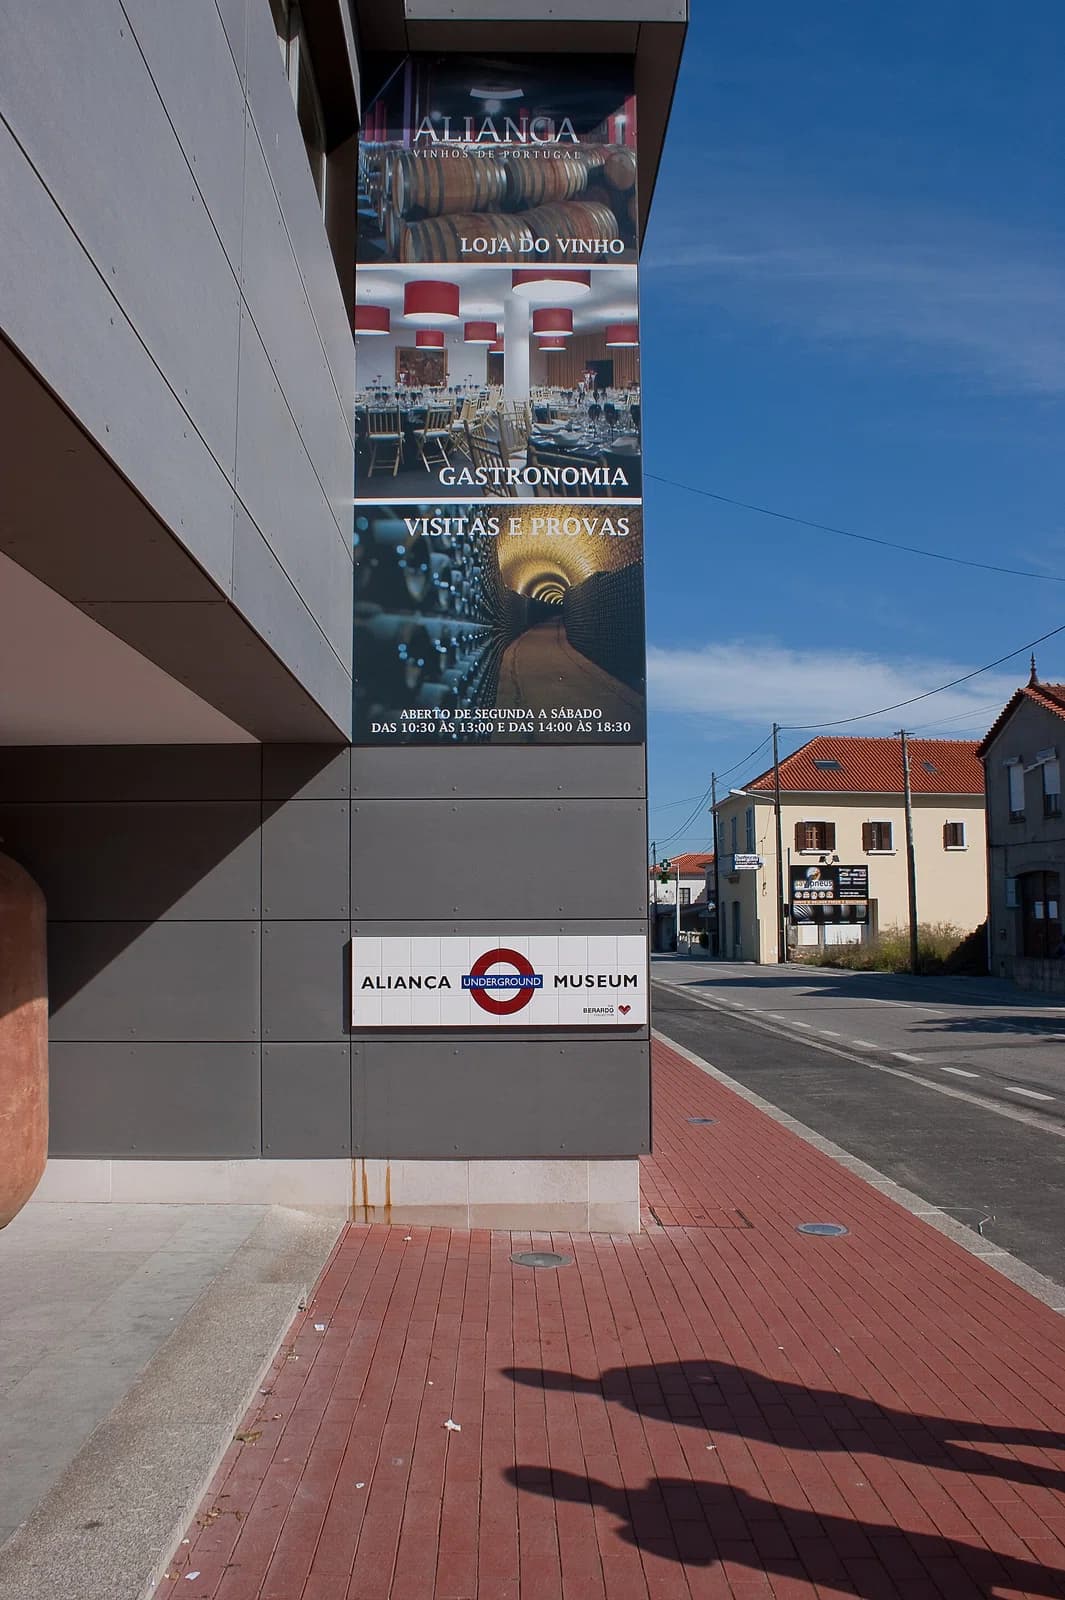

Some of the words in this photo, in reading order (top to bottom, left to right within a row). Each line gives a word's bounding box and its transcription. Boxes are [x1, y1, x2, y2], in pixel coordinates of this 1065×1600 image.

[413, 150, 469, 159] VINHOS
[478, 150, 495, 159] DE
[504, 150, 581, 160] PORTUGAL
[461, 237, 512, 254] LOJA
[519, 238, 550, 253] DO
[557, 238, 625, 254] VINHO
[438, 467, 629, 486] GASTRONOMIA
[404, 518, 500, 536] VISITAS
[508, 518, 522, 535] E
[531, 518, 630, 536] PROVAS
[400, 709, 450, 719] ABERTO
[454, 709, 471, 719] DE
[475, 709, 534, 719] SEGUNDA
[538, 709, 547, 719] A
[551, 706, 602, 719] SÁBADO
[371, 723, 397, 733] DAS
[401, 722, 435, 733] 10:30
[439, 720, 455, 733] ÀS
[460, 722, 494, 733] 13:00
[498, 723, 505, 732] E
[509, 722, 534, 732] DAS
[539, 722, 572, 732] 14:00
[576, 719, 592, 732] ÀS
[597, 721, 631, 732] 18:30
[361, 975, 451, 990] ALIANÇA
[463, 977, 541, 987] UNDERGROUND
[554, 974, 638, 988] MUSEUM
